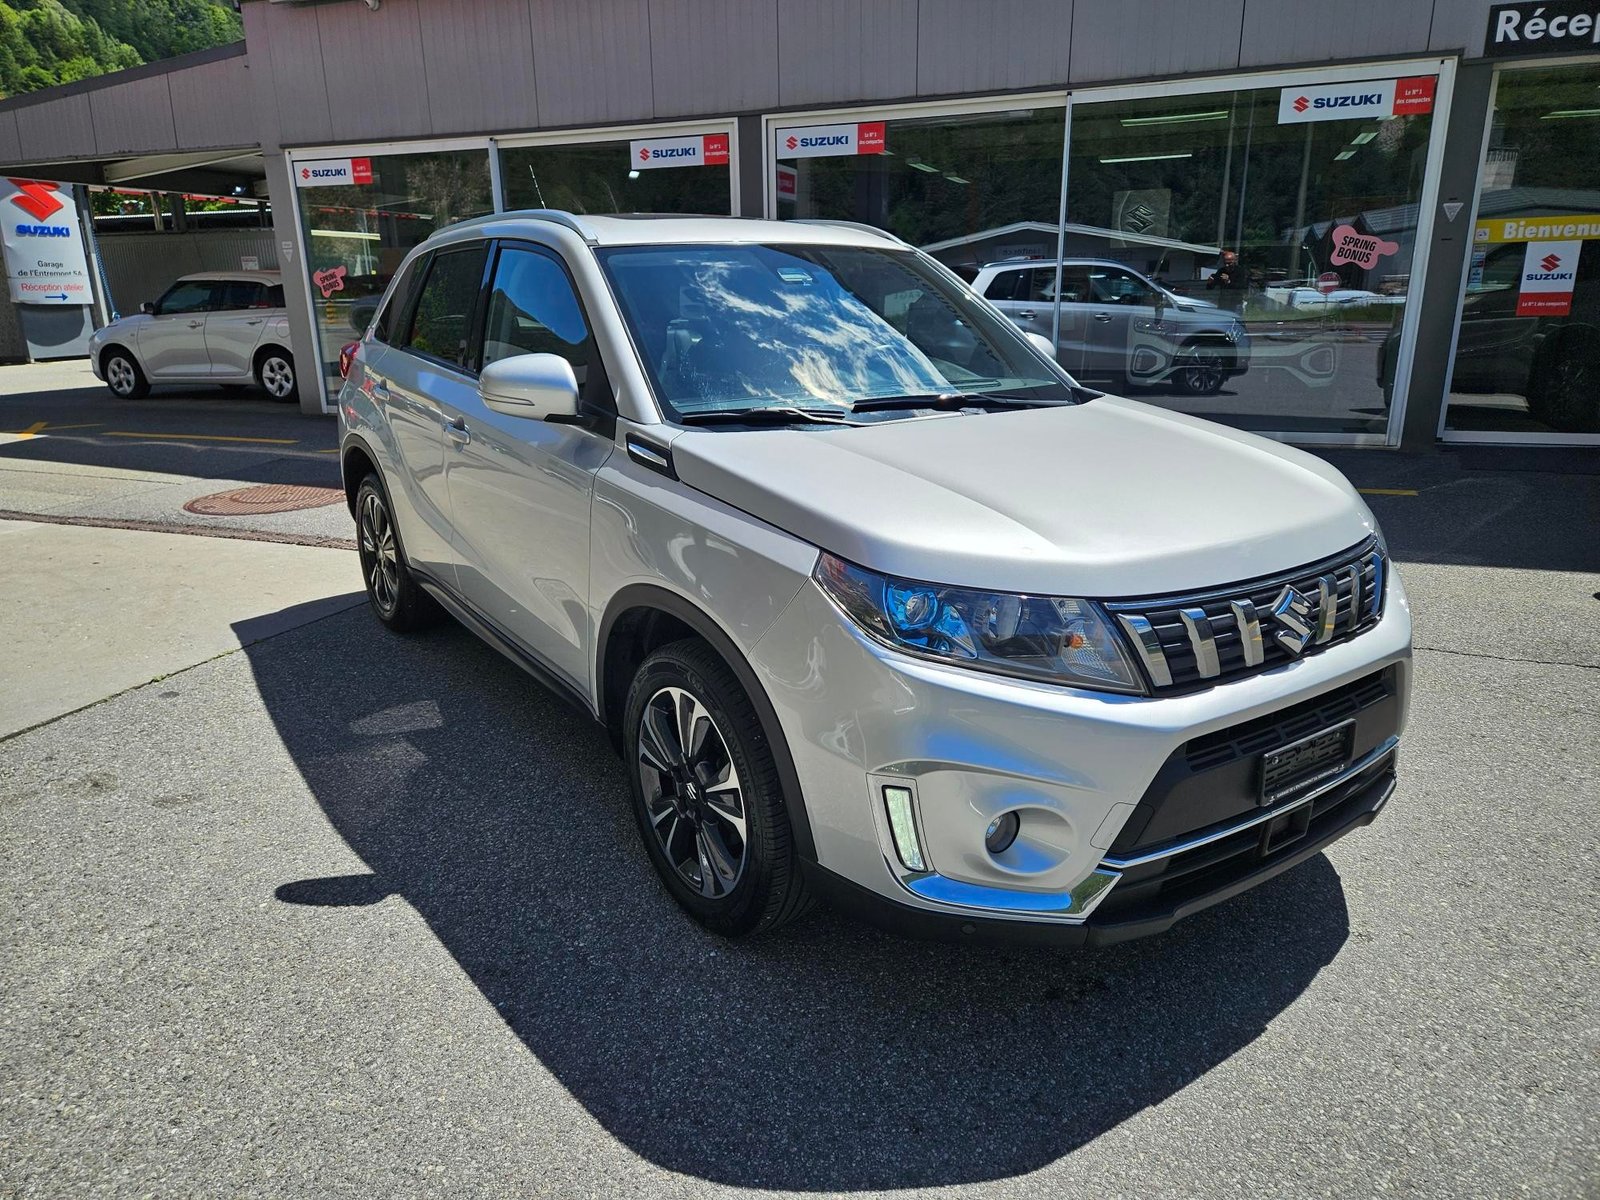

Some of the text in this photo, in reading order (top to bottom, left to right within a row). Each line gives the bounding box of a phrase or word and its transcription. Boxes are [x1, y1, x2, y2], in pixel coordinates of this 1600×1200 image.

[1313, 94, 1382, 109] SUZUKI
[800, 136, 849, 147] SUZUKI
[652, 147, 696, 158] SUZUKI
[312, 168, 346, 178] SUZUKI
[16, 225, 70, 237] SUZUKI
[1341, 235, 1377, 252] SPRING
[1337, 246, 1372, 263] BONUS
[37, 260, 64, 269] Garage
[320, 272, 337, 284] SPRING
[1526, 273, 1573, 281] SUZUKI
[21, 282, 63, 292] Réception
